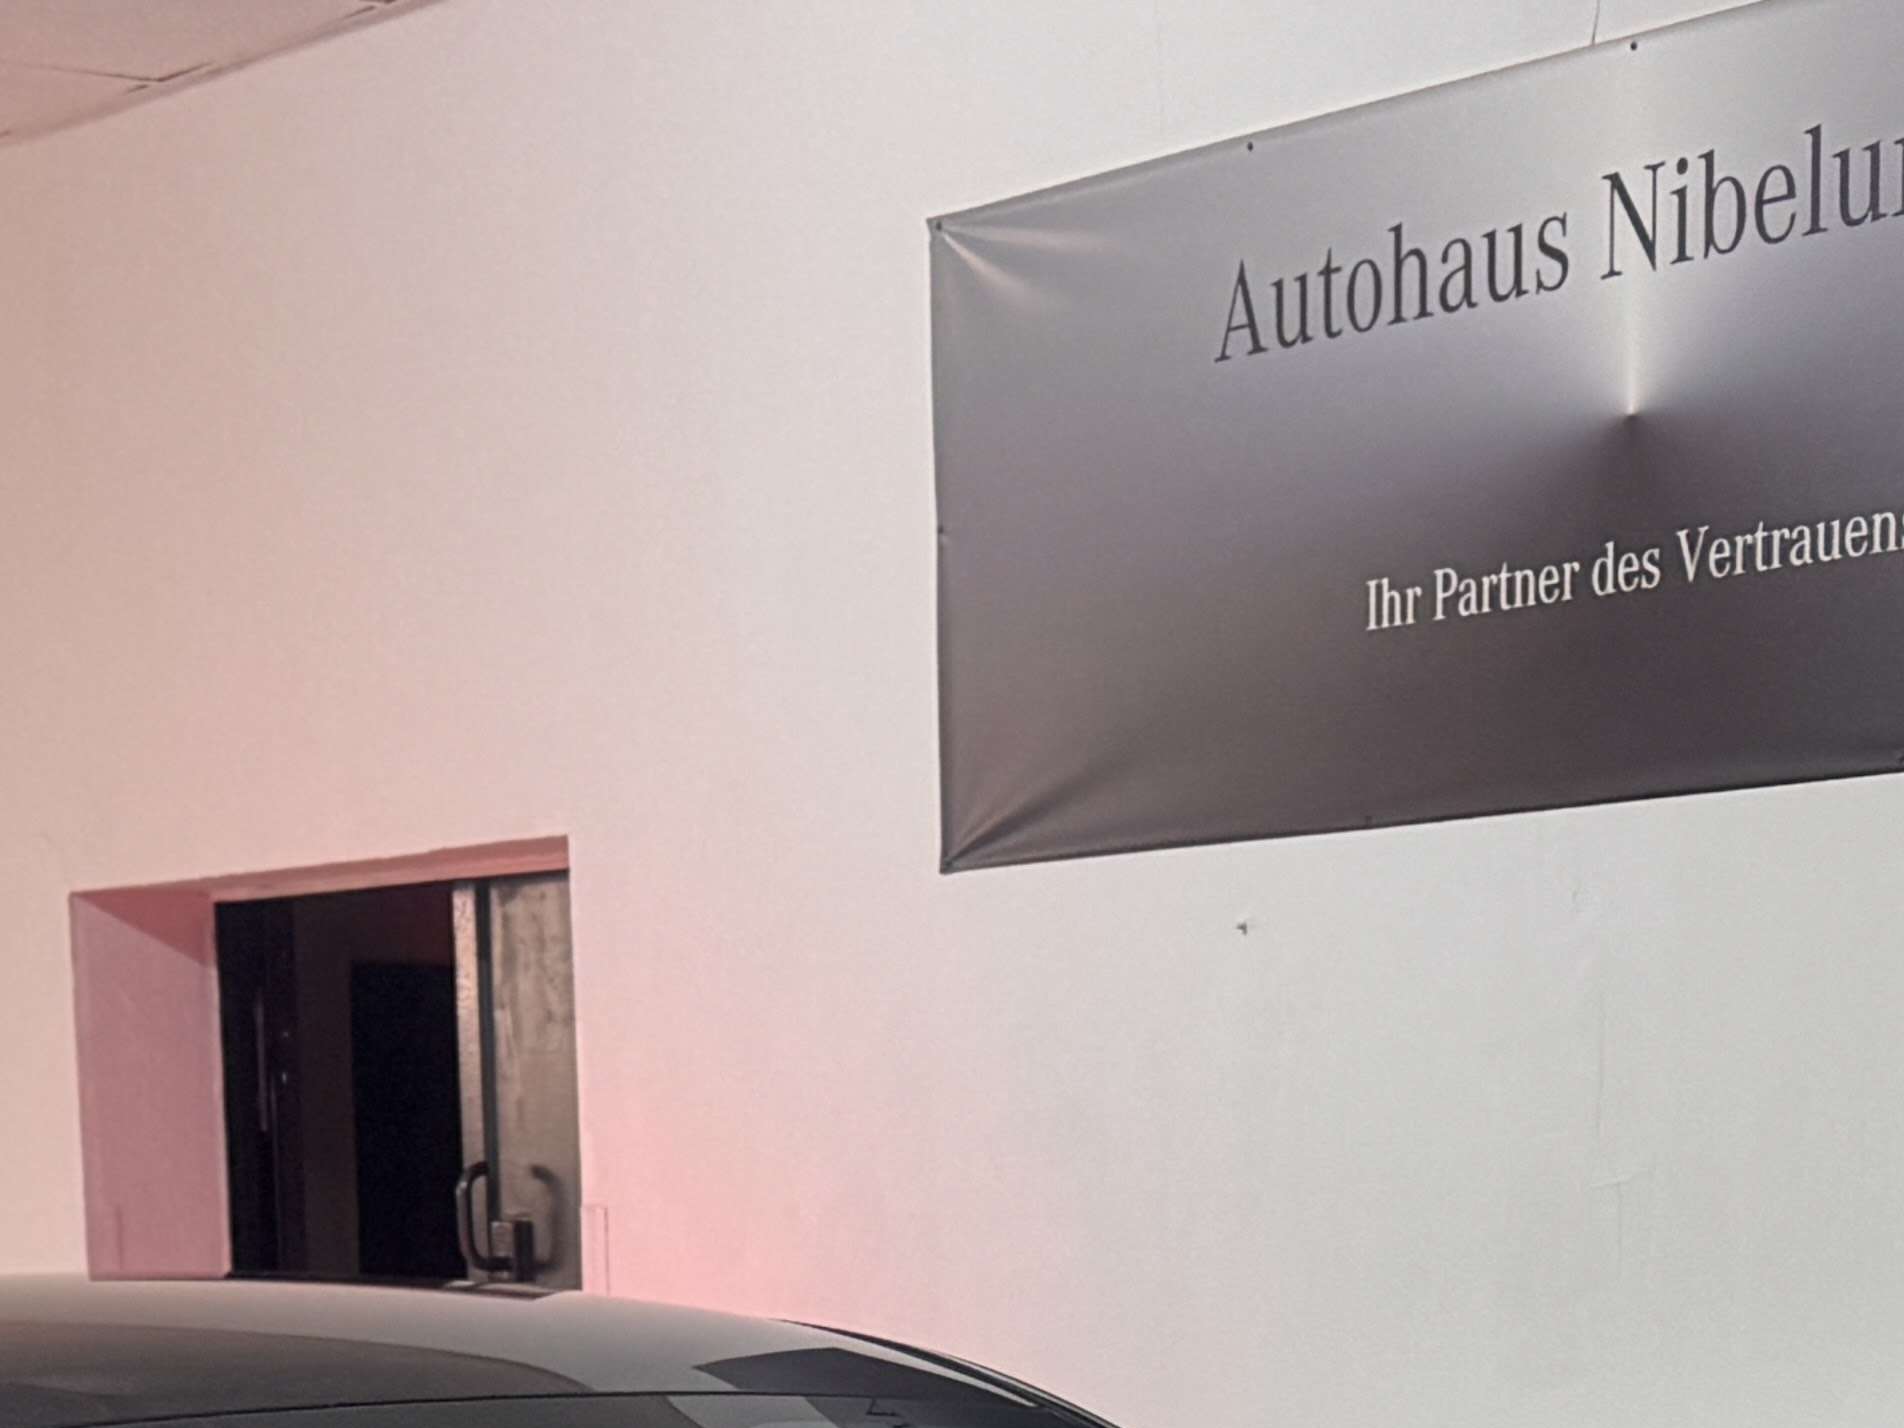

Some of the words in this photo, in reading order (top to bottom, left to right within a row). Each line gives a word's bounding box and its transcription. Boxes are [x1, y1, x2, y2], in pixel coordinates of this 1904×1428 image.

[1213, 210, 1570, 364] Autohaus
[1365, 578, 1422, 631] Ihr
[1432, 560, 1580, 621] Partner
[1591, 540, 1661, 598] des
